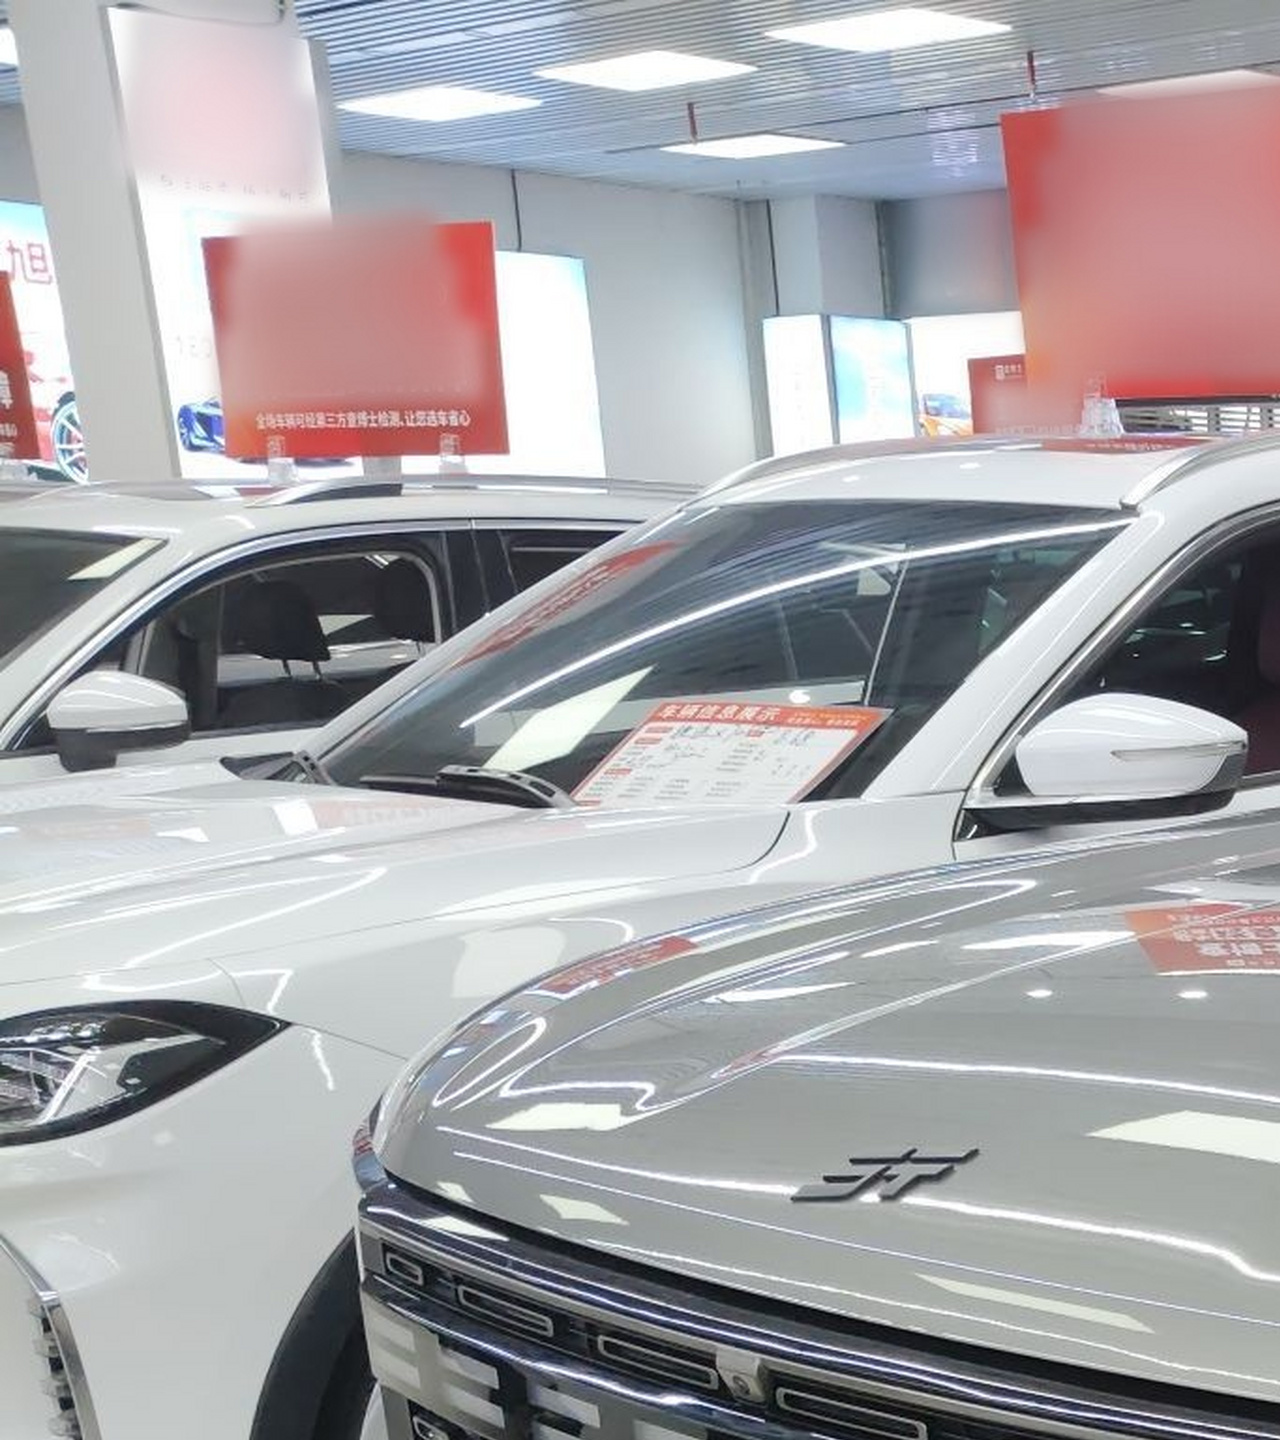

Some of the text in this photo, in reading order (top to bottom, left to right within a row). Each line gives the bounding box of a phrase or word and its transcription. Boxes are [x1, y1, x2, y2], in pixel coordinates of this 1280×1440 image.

[659, 703, 782, 722] 车辆信息展示
